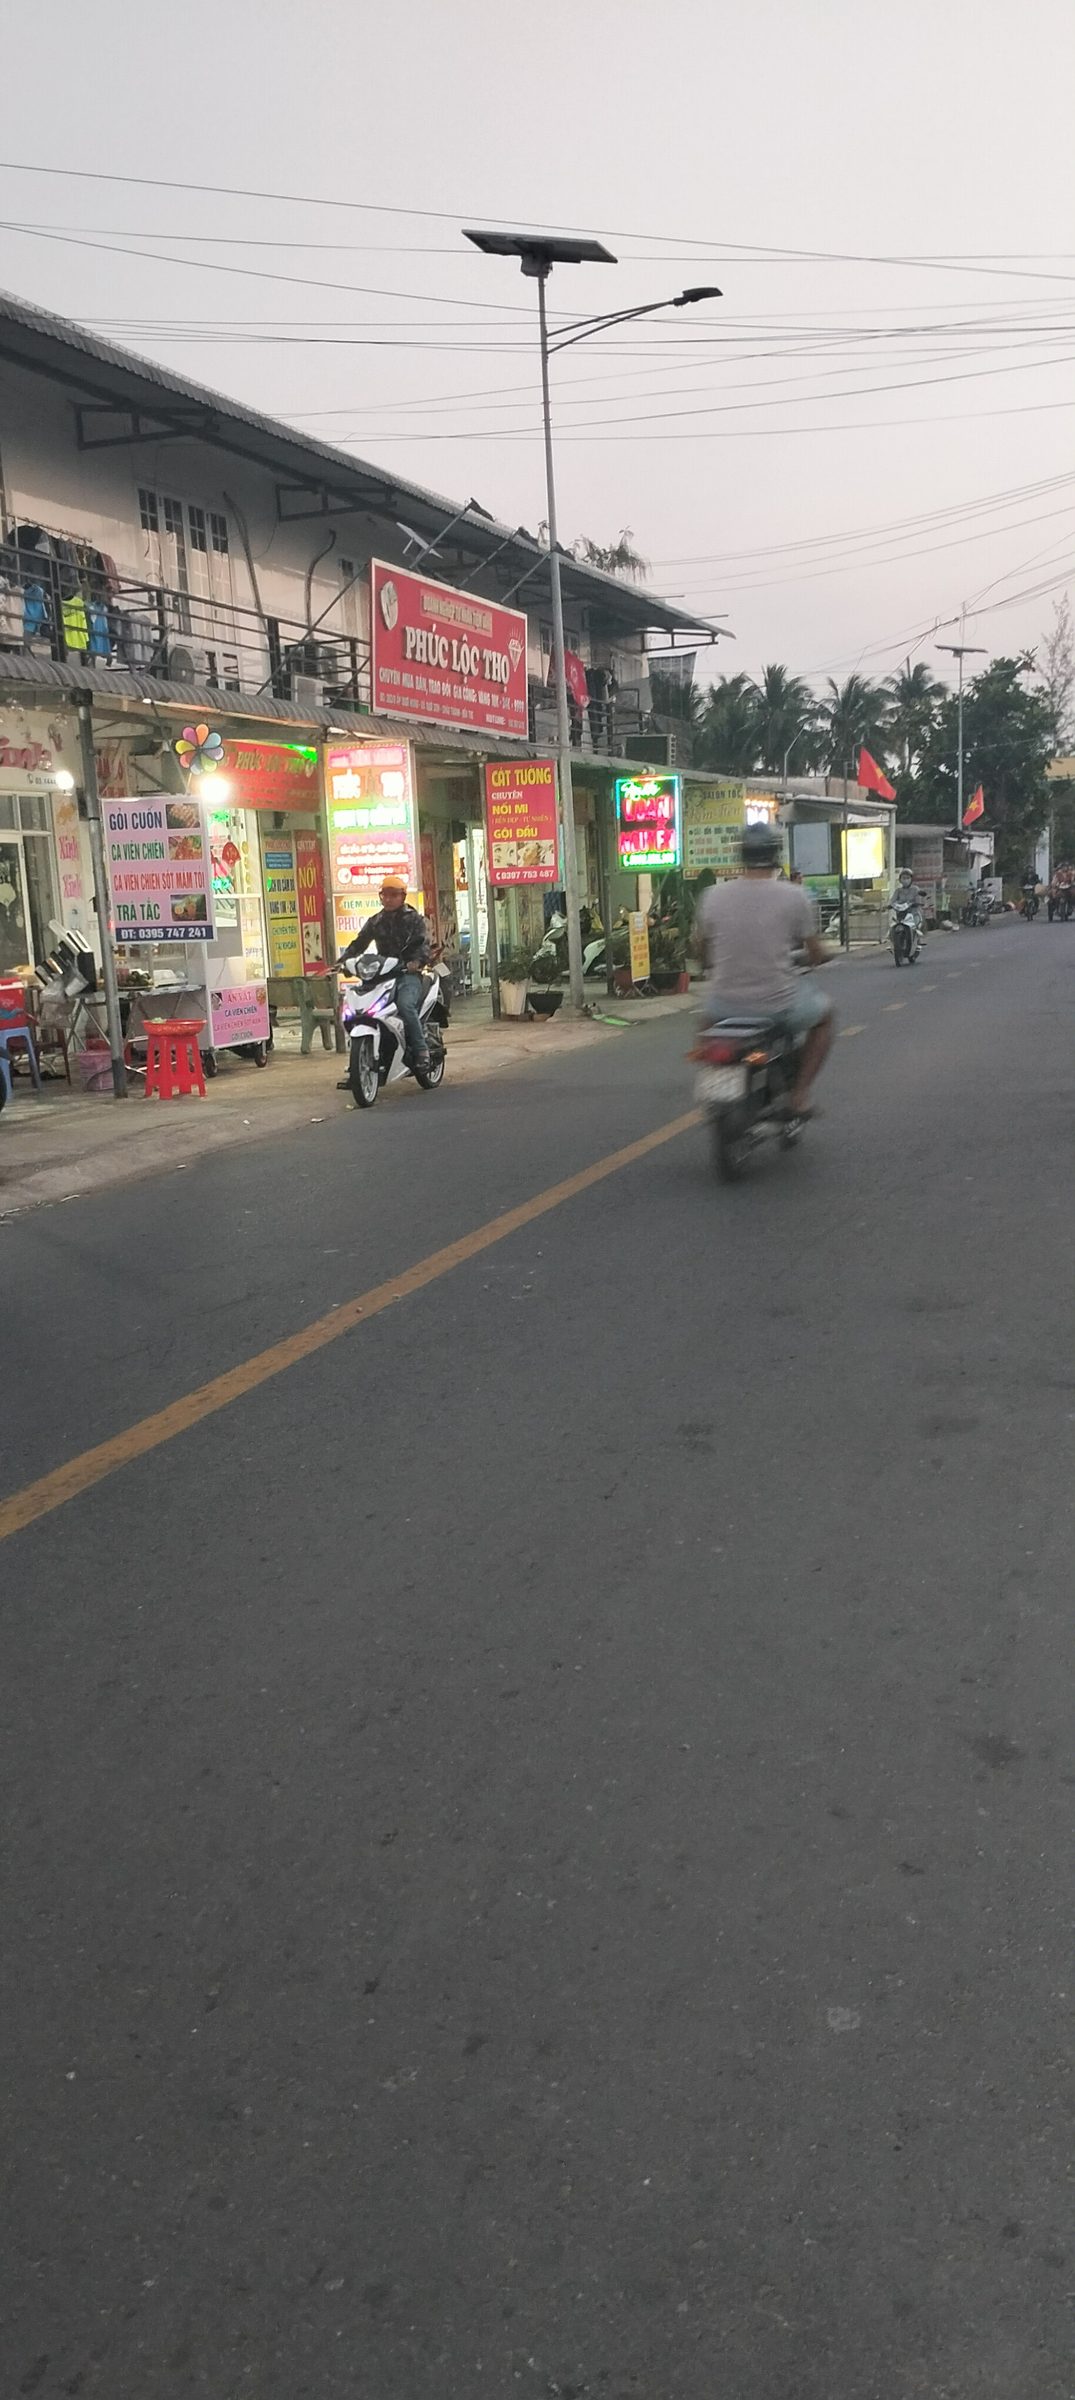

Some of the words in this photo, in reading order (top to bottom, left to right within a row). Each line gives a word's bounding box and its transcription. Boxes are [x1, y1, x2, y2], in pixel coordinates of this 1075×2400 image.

[405, 623, 448, 669] PHÚC
[452, 633, 480, 684] LỘC
[482, 648, 510, 694] THỌ
[236, 748, 263, 770] PHÚC
[492, 767, 511, 787] CÁT
[492, 790, 523, 800] CHUYÊN
[492, 801, 511, 814] NỐI
[515, 803, 528, 814] MI
[109, 807, 127, 830] GỎI
[132, 806, 163, 829] CUỐN
[493, 827, 512, 840] GỘI
[516, 825, 538, 838] ĐẦU
[123, 840, 140, 860] VIÊN
[142, 839, 164, 860] CHIÊN
[299, 860, 317, 888] NỐI
[117, 900, 137, 921] TRÀ
[140, 897, 161, 920] TẮC
[304, 896, 316, 916] MI
[121, 929, 137, 939] ĐT:
[140, 928, 164, 939] 0395
[166, 928, 185, 938] 747
[188, 927, 206, 938] 241
